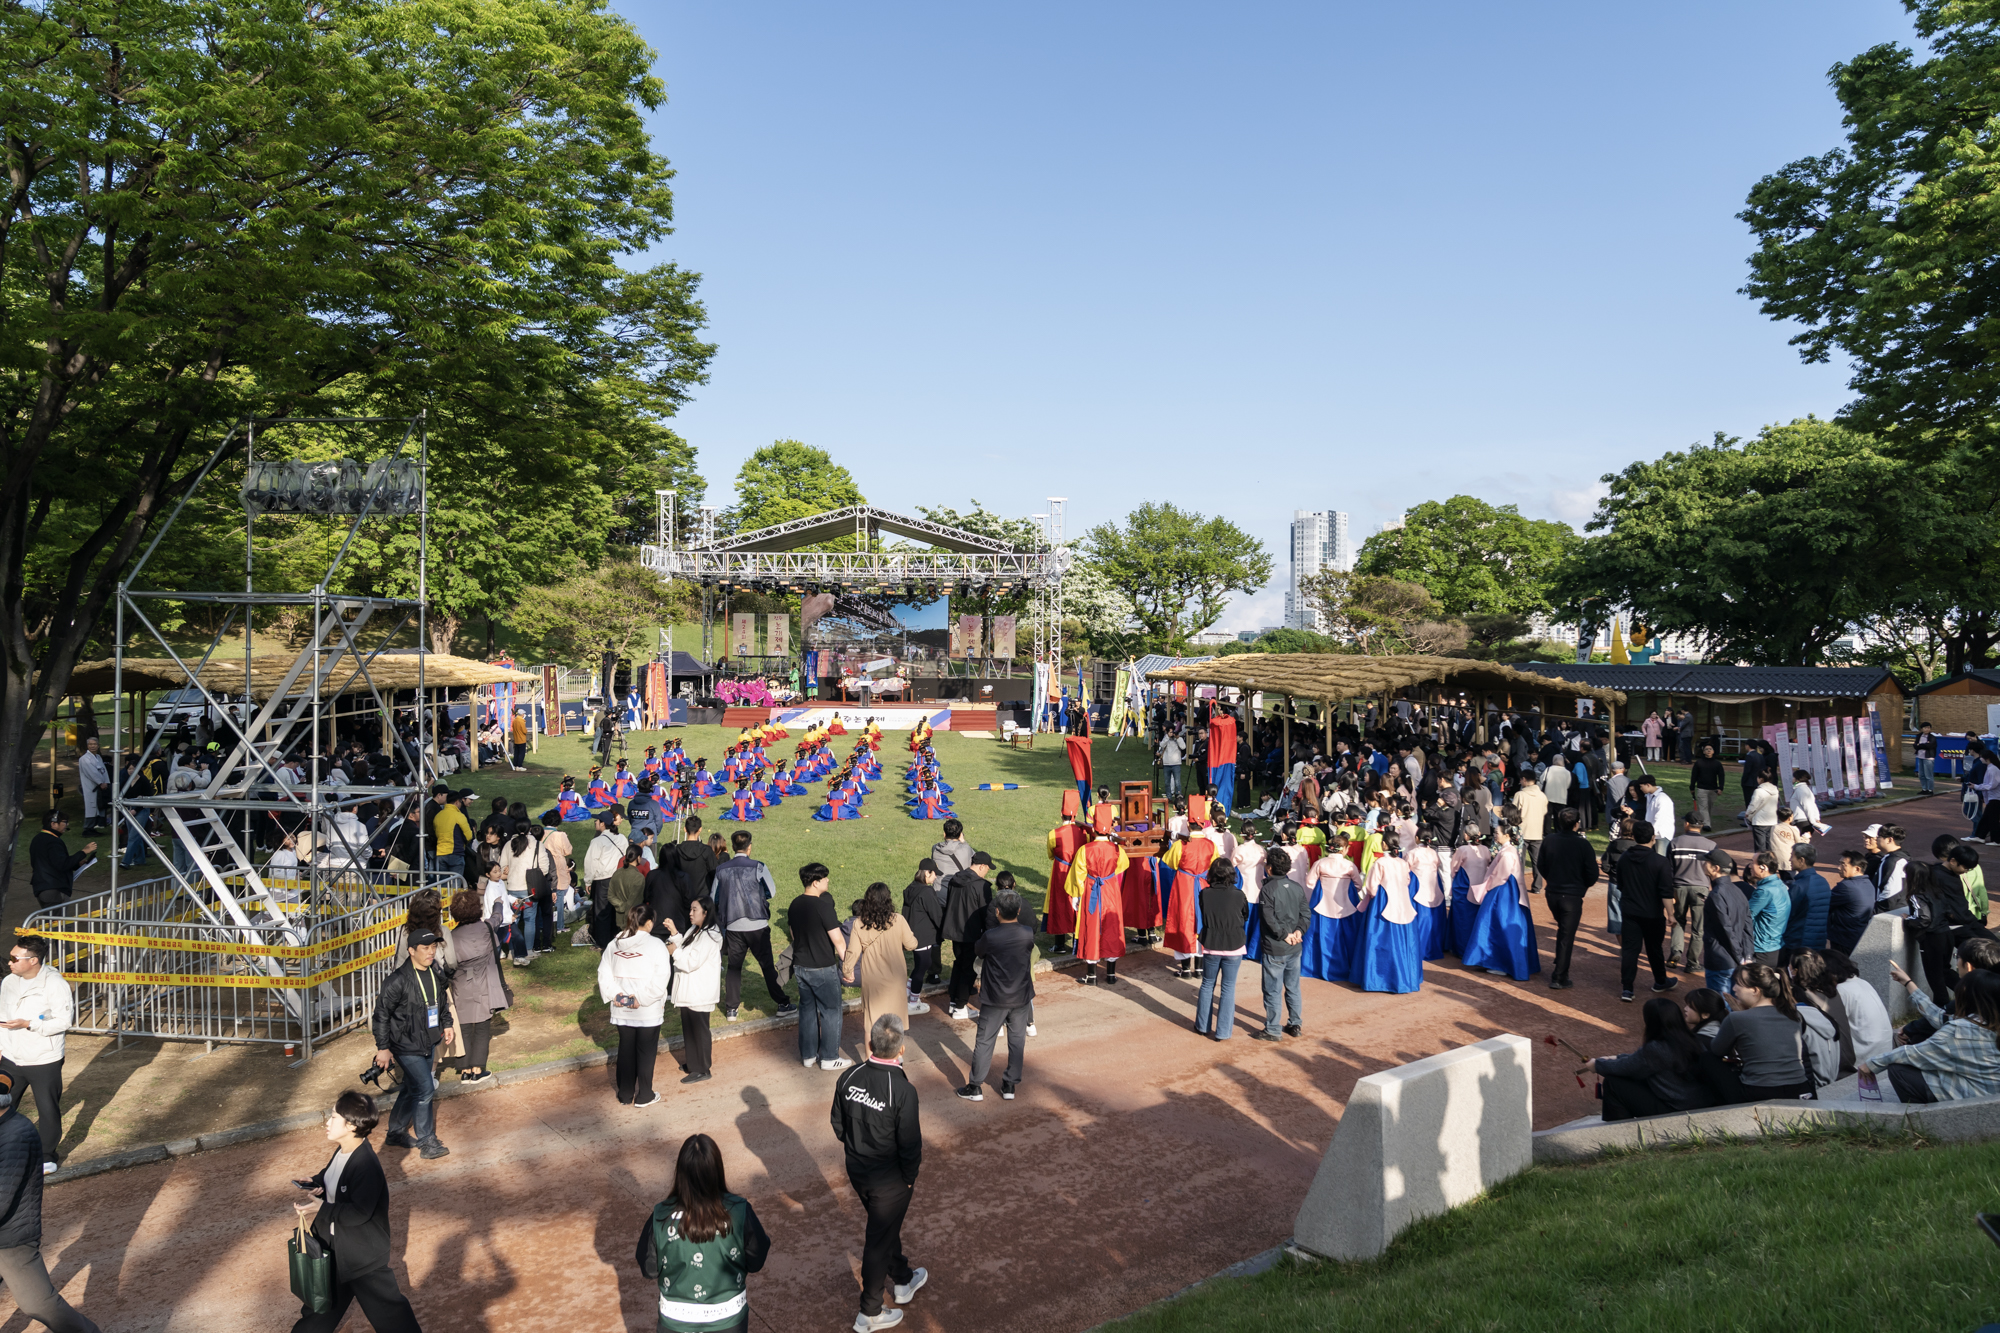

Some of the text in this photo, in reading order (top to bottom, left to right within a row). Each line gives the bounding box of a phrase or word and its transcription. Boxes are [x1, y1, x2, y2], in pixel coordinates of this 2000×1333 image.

[332, 937, 346, 948] 출입금지
[295, 948, 314, 956] 출입금지
[270, 978, 280, 986] 위험
[845, 1085, 886, 1111] Titleist
